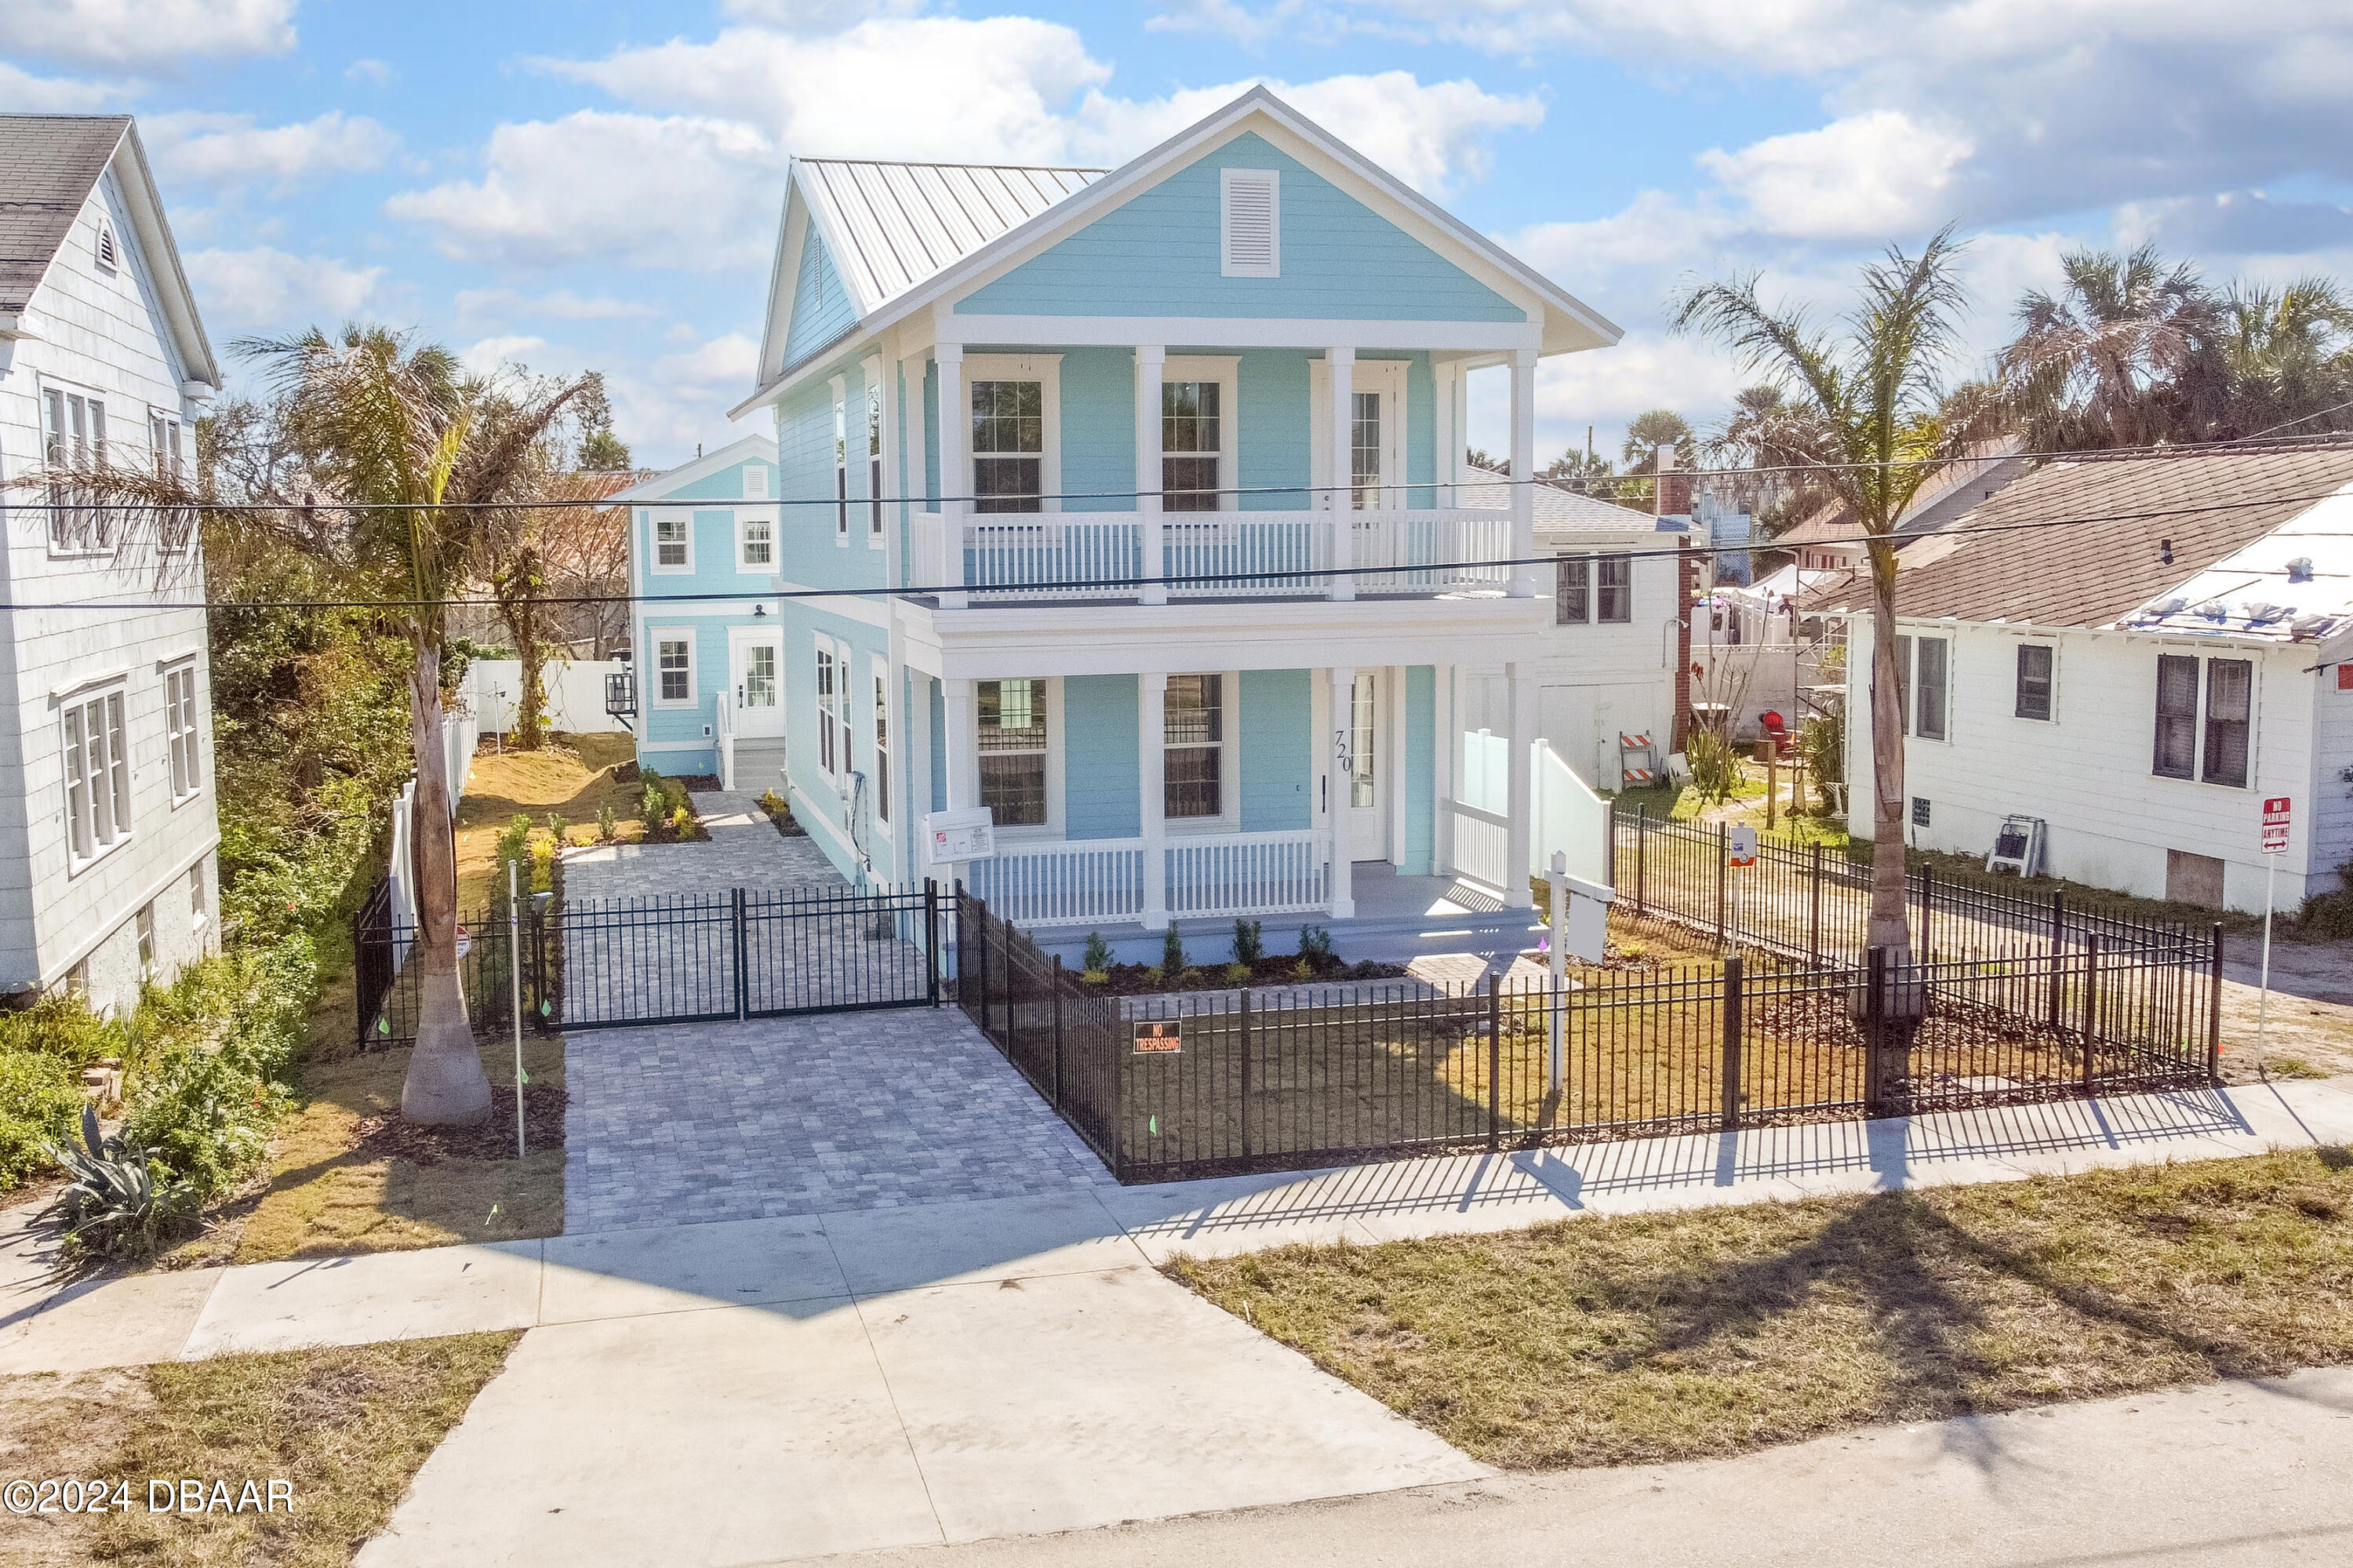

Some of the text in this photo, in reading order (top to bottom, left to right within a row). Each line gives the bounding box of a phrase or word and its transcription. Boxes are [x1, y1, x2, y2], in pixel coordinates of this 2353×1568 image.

[1336, 730, 1351, 772] 720
[2273, 801, 2282, 812] NO
[2264, 811, 2289, 824] PARKING
[2263, 828, 2289, 839] ANYTIME
[1152, 1024, 1163, 1037] NO
[1136, 1036, 1179, 1051] TRESPASSING
